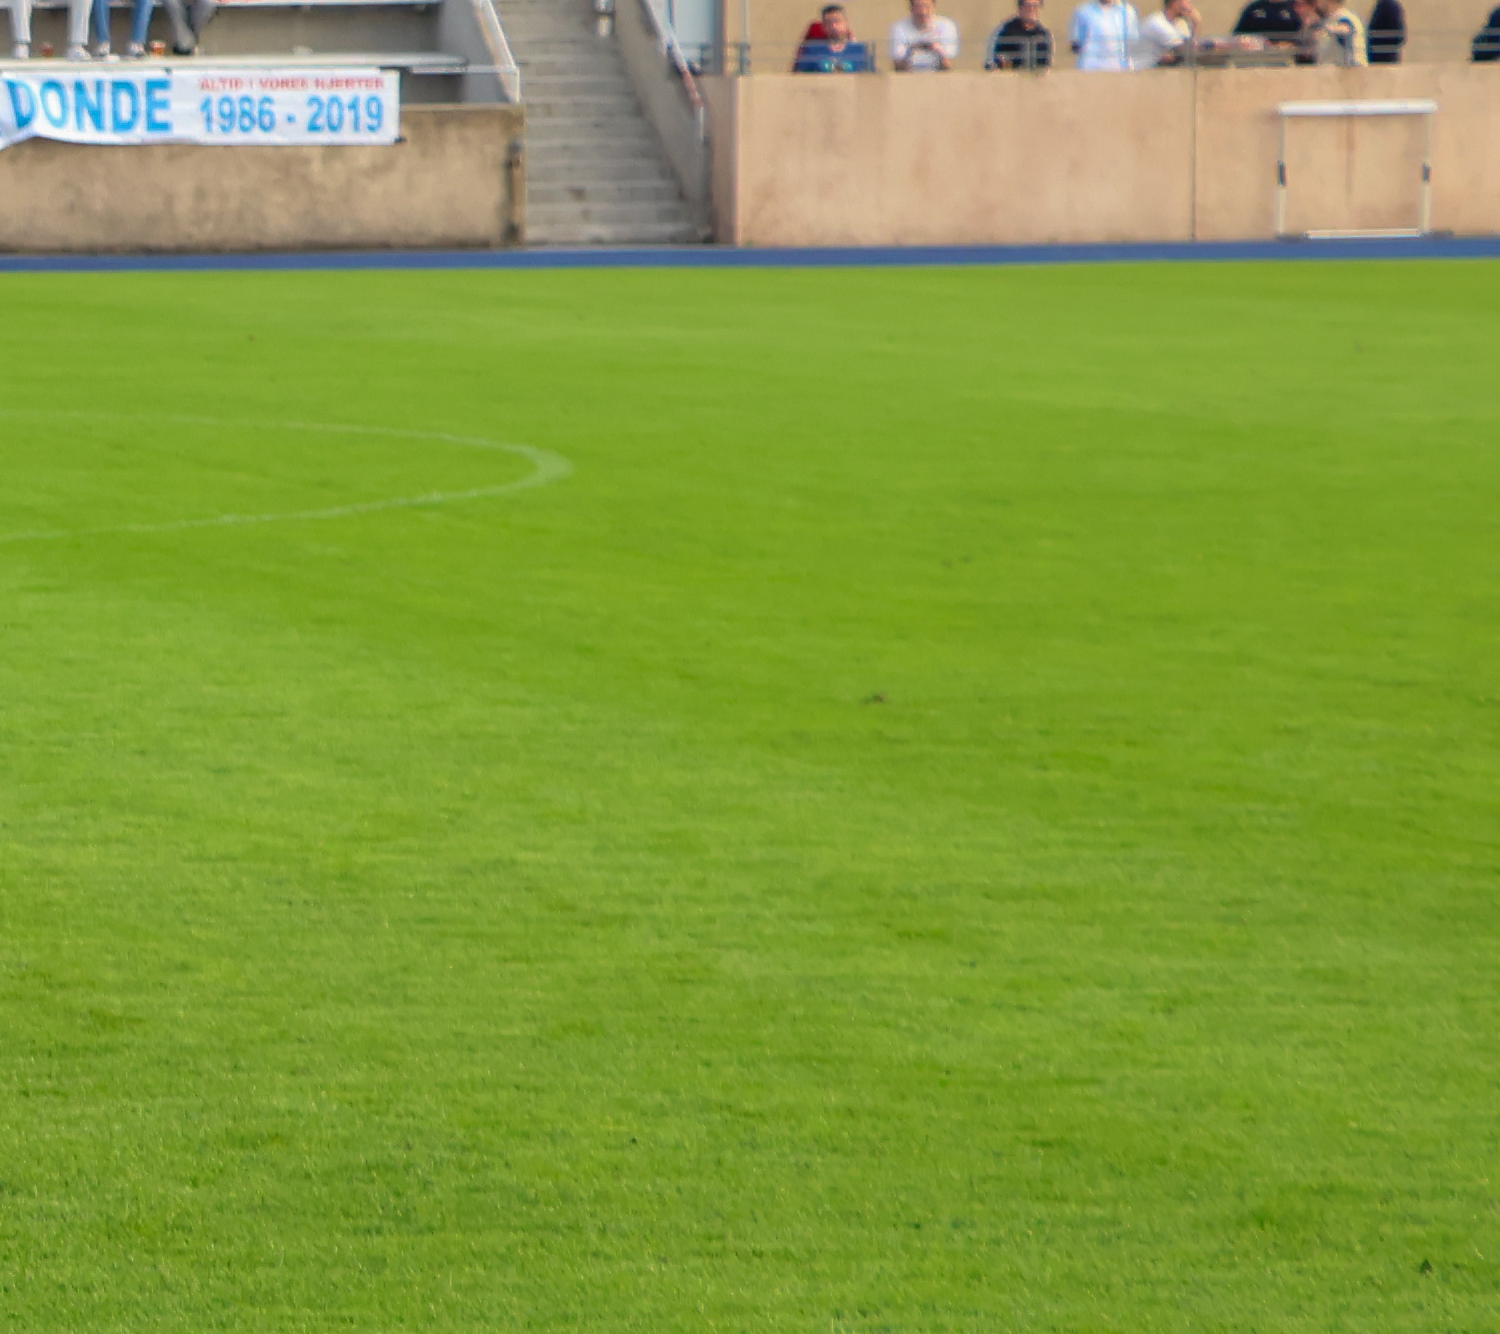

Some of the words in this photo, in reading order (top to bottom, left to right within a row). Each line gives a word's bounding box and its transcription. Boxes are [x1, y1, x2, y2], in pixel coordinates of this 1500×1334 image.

[2, 78, 172, 132] DONDE
[200, 94, 276, 134] 1986
[306, 94, 383, 133] 2019
